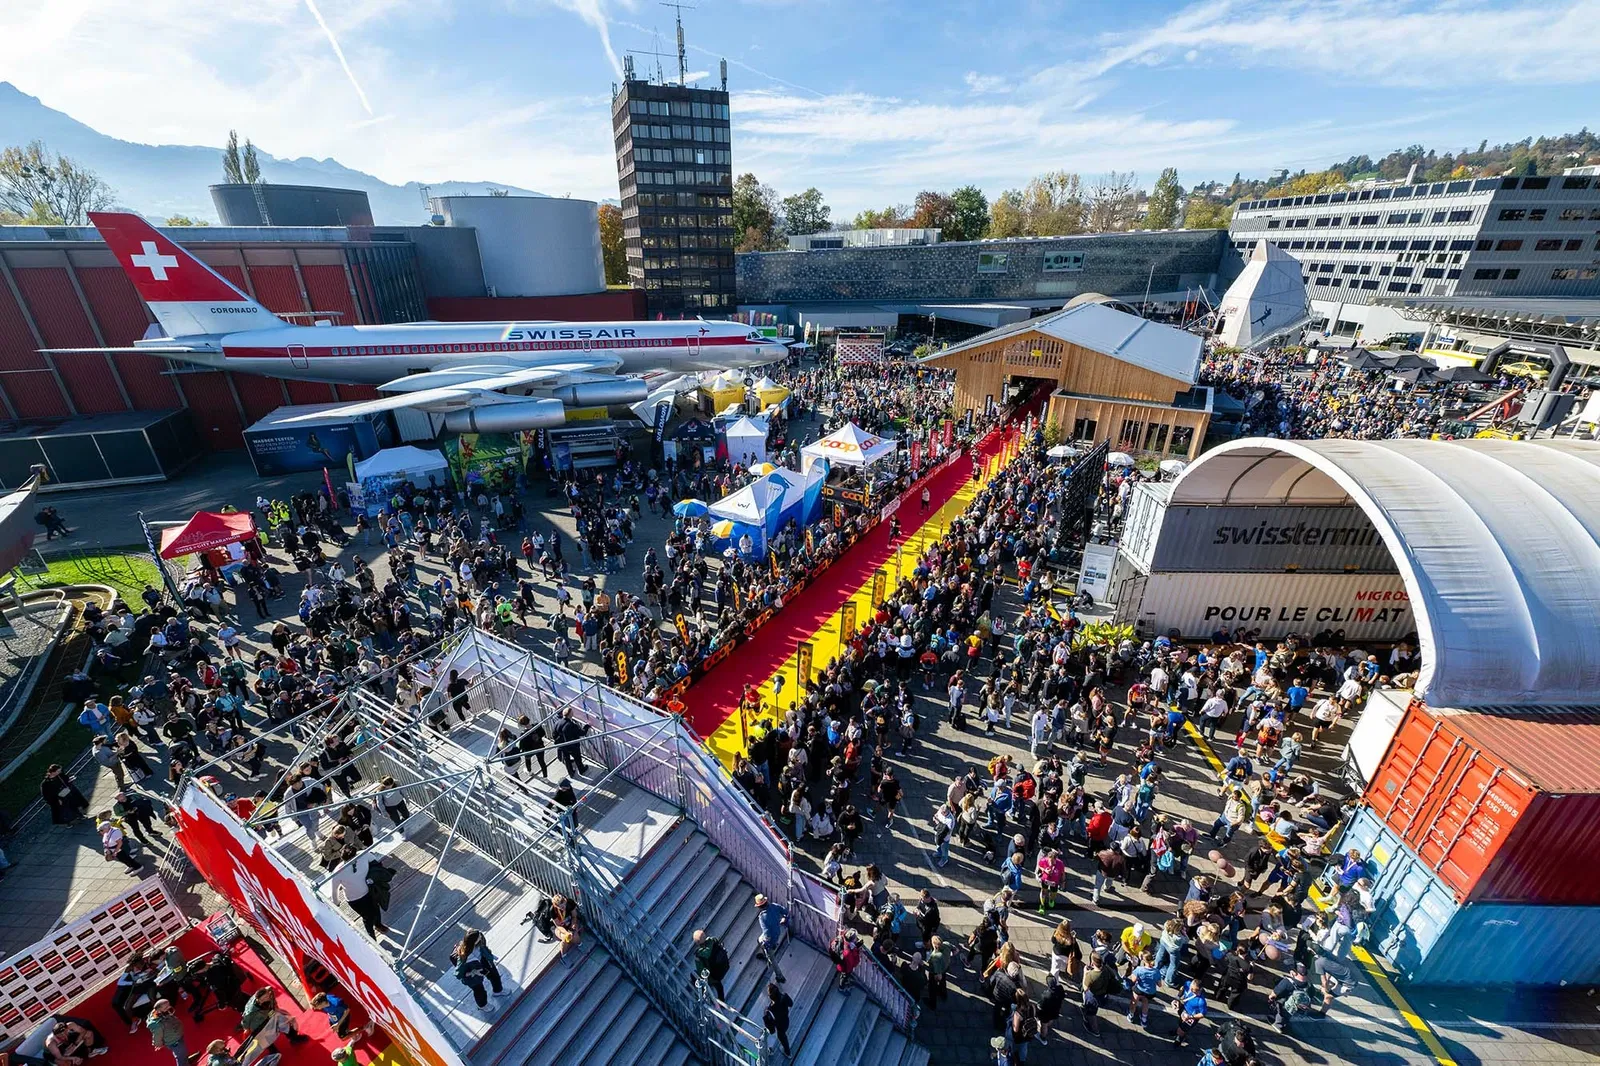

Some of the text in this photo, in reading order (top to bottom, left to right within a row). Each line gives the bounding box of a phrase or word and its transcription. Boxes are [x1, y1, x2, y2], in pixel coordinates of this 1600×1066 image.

[508, 328, 636, 340] SWISSAIR
[656, 404, 668, 442] SALOMON
[821, 439, 858, 452] coop
[676, 613, 690, 645] coop
[844, 606, 855, 640] coop
[1204, 606, 1405, 622] POUR LE CLIMAT
[618, 651, 628, 684] coop
[703, 639, 736, 671] coop
[226, 848, 338, 972] THANK
[332, 952, 421, 1052] YOU
